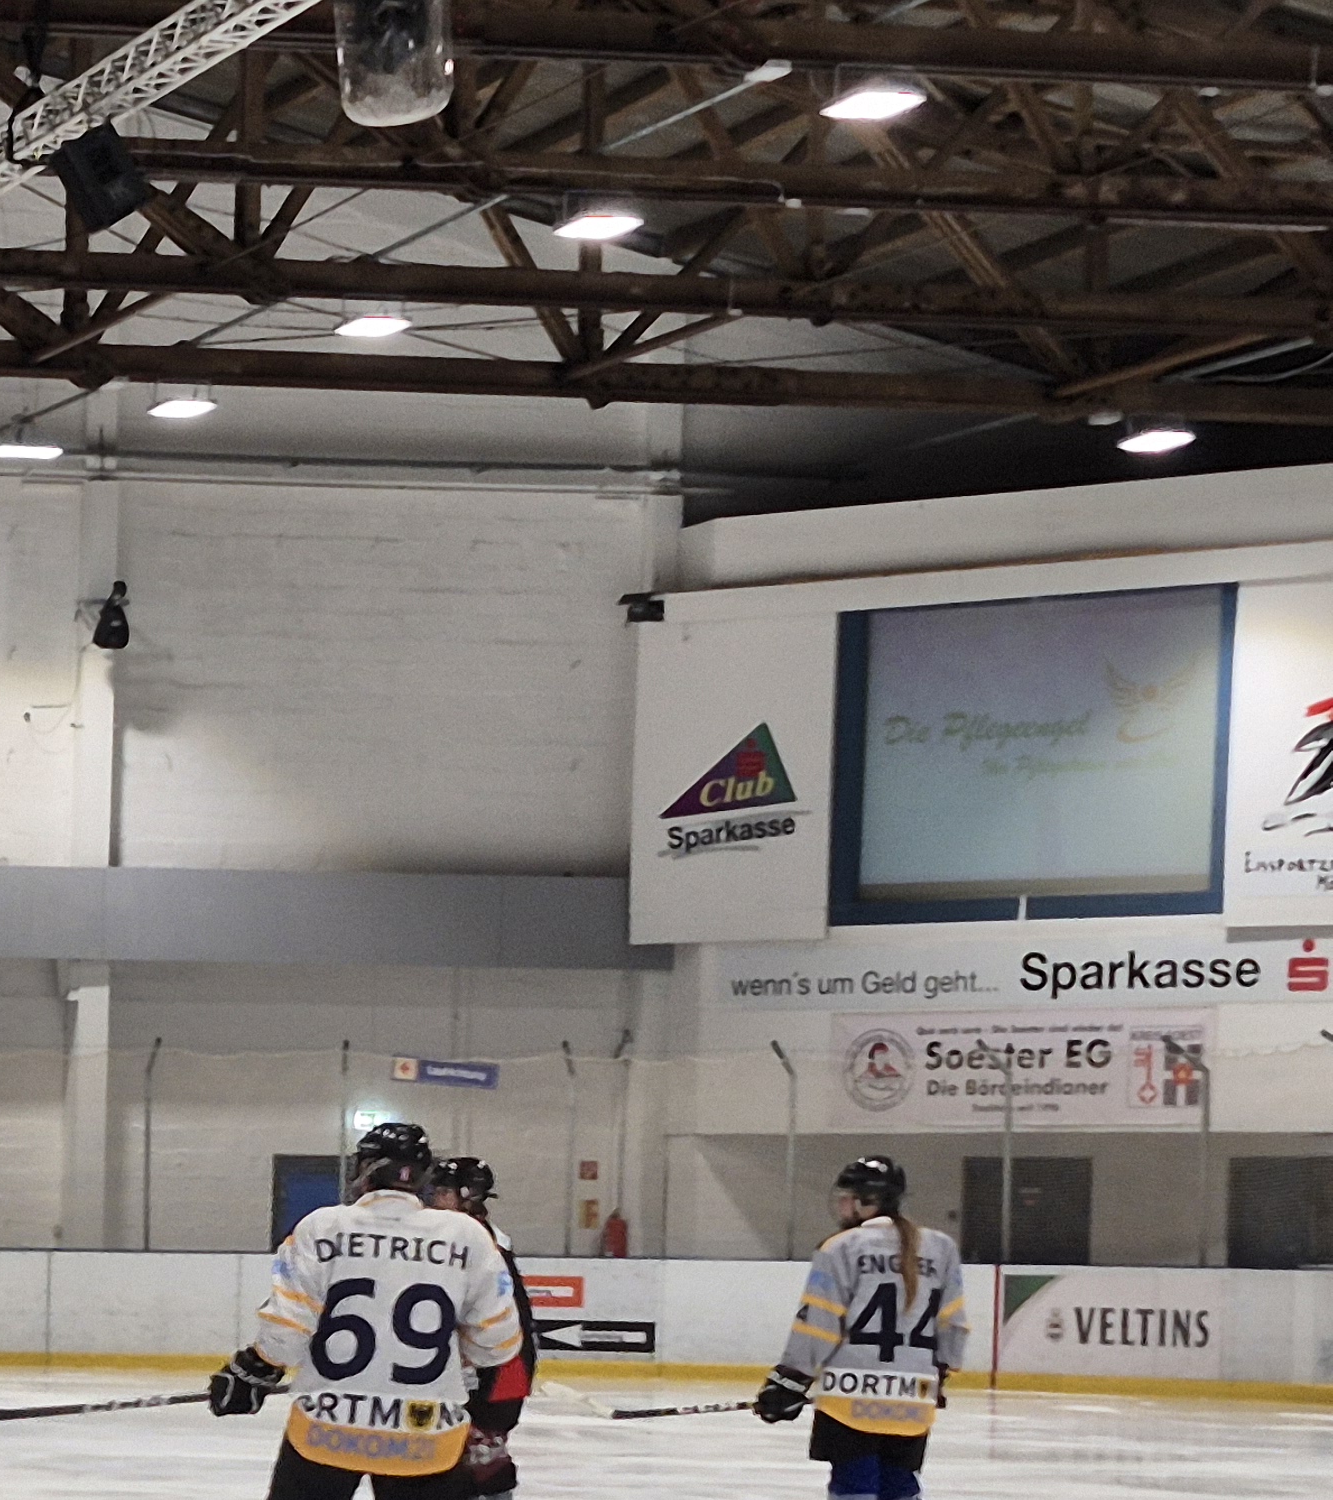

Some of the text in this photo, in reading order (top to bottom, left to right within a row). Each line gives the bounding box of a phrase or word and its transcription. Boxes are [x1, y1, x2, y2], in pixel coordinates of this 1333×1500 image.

[699, 769, 775, 808] Club
[666, 816, 796, 853] Sparkasse
[817, 975, 855, 995] um
[861, 969, 917, 995] Geld
[1019, 950, 1262, 1000] Sparkasse
[1065, 1038, 1113, 1070] EG
[926, 1078, 959, 1098] Die
[315, 1232, 469, 1270] DIETRICH
[309, 1278, 455, 1384] 69
[1073, 1306, 1210, 1348] VELTINS
